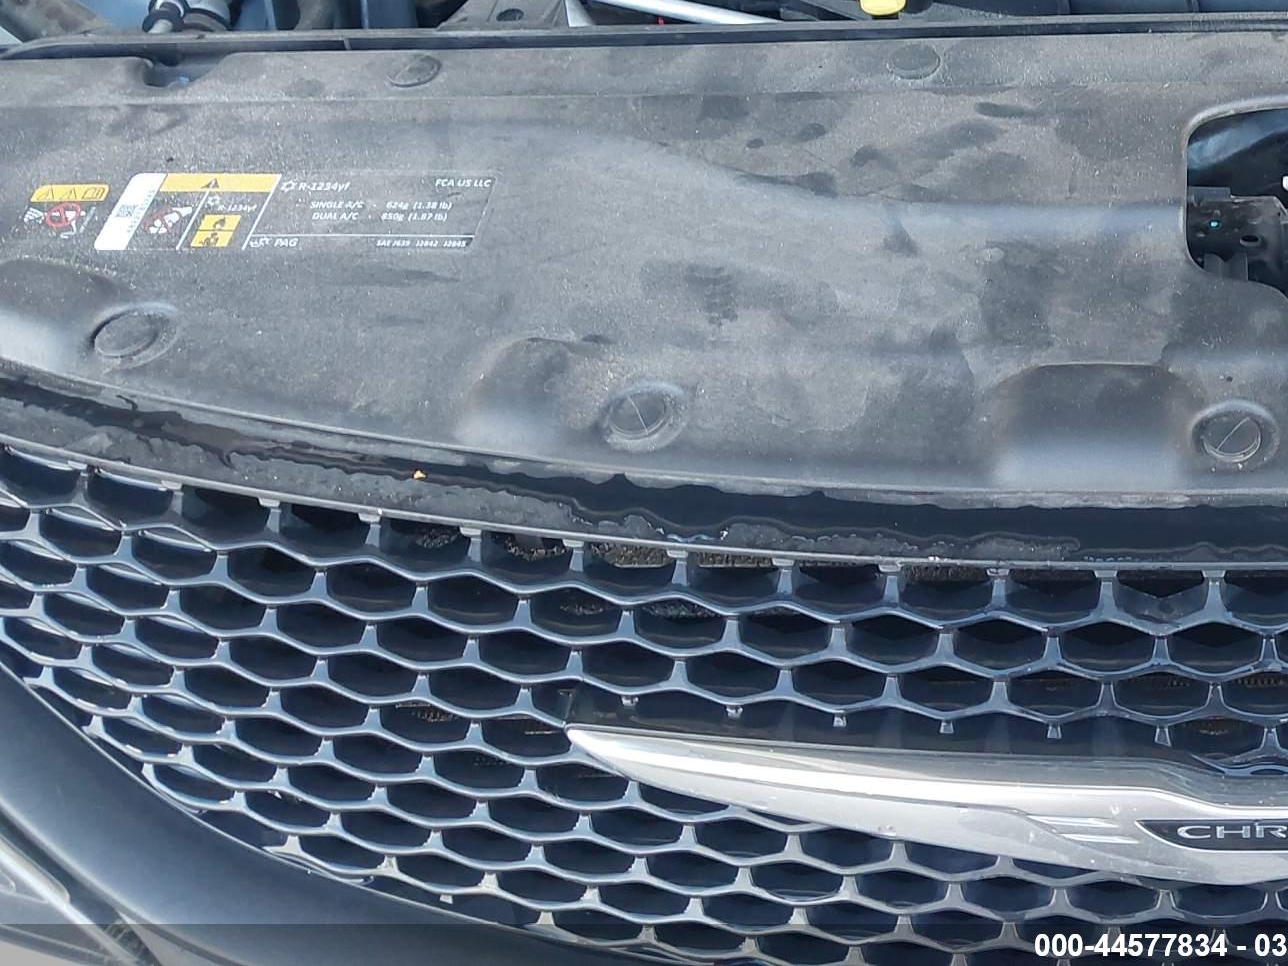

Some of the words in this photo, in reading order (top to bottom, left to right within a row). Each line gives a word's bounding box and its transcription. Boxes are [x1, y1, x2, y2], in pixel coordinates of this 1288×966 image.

[435, 178, 455, 188] FCA
[457, 178, 473, 188] US
[473, 178, 492, 188] LLC
[310, 200, 343, 210] SINGLE
[311, 211, 338, 221] DUAL
[339, 211, 360, 221] A/C
[274, 237, 299, 247] PAG
